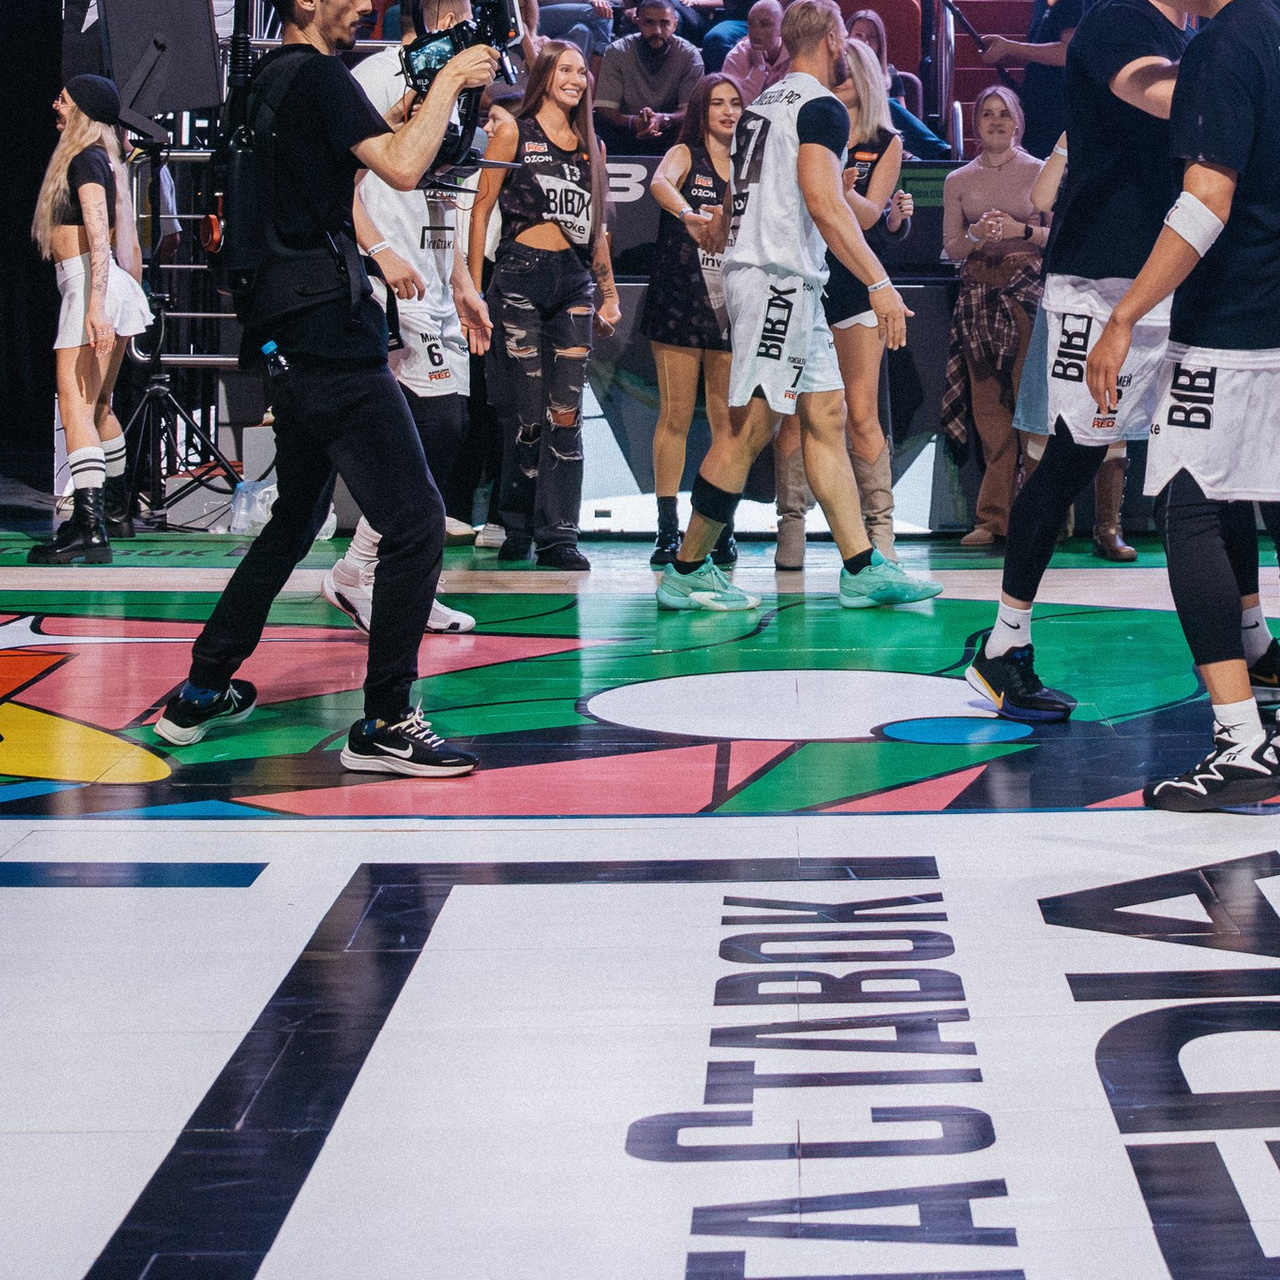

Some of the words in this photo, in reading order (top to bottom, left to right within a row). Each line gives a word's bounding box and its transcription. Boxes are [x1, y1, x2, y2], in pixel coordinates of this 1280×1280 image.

[524, 155, 553, 163] OZON
[562, 163, 581, 181] 13
[691, 188, 717, 198] OZON
[427, 343, 444, 367] 6
[790, 365, 804, 388] 7
[1092, 420, 1116, 428] RED
